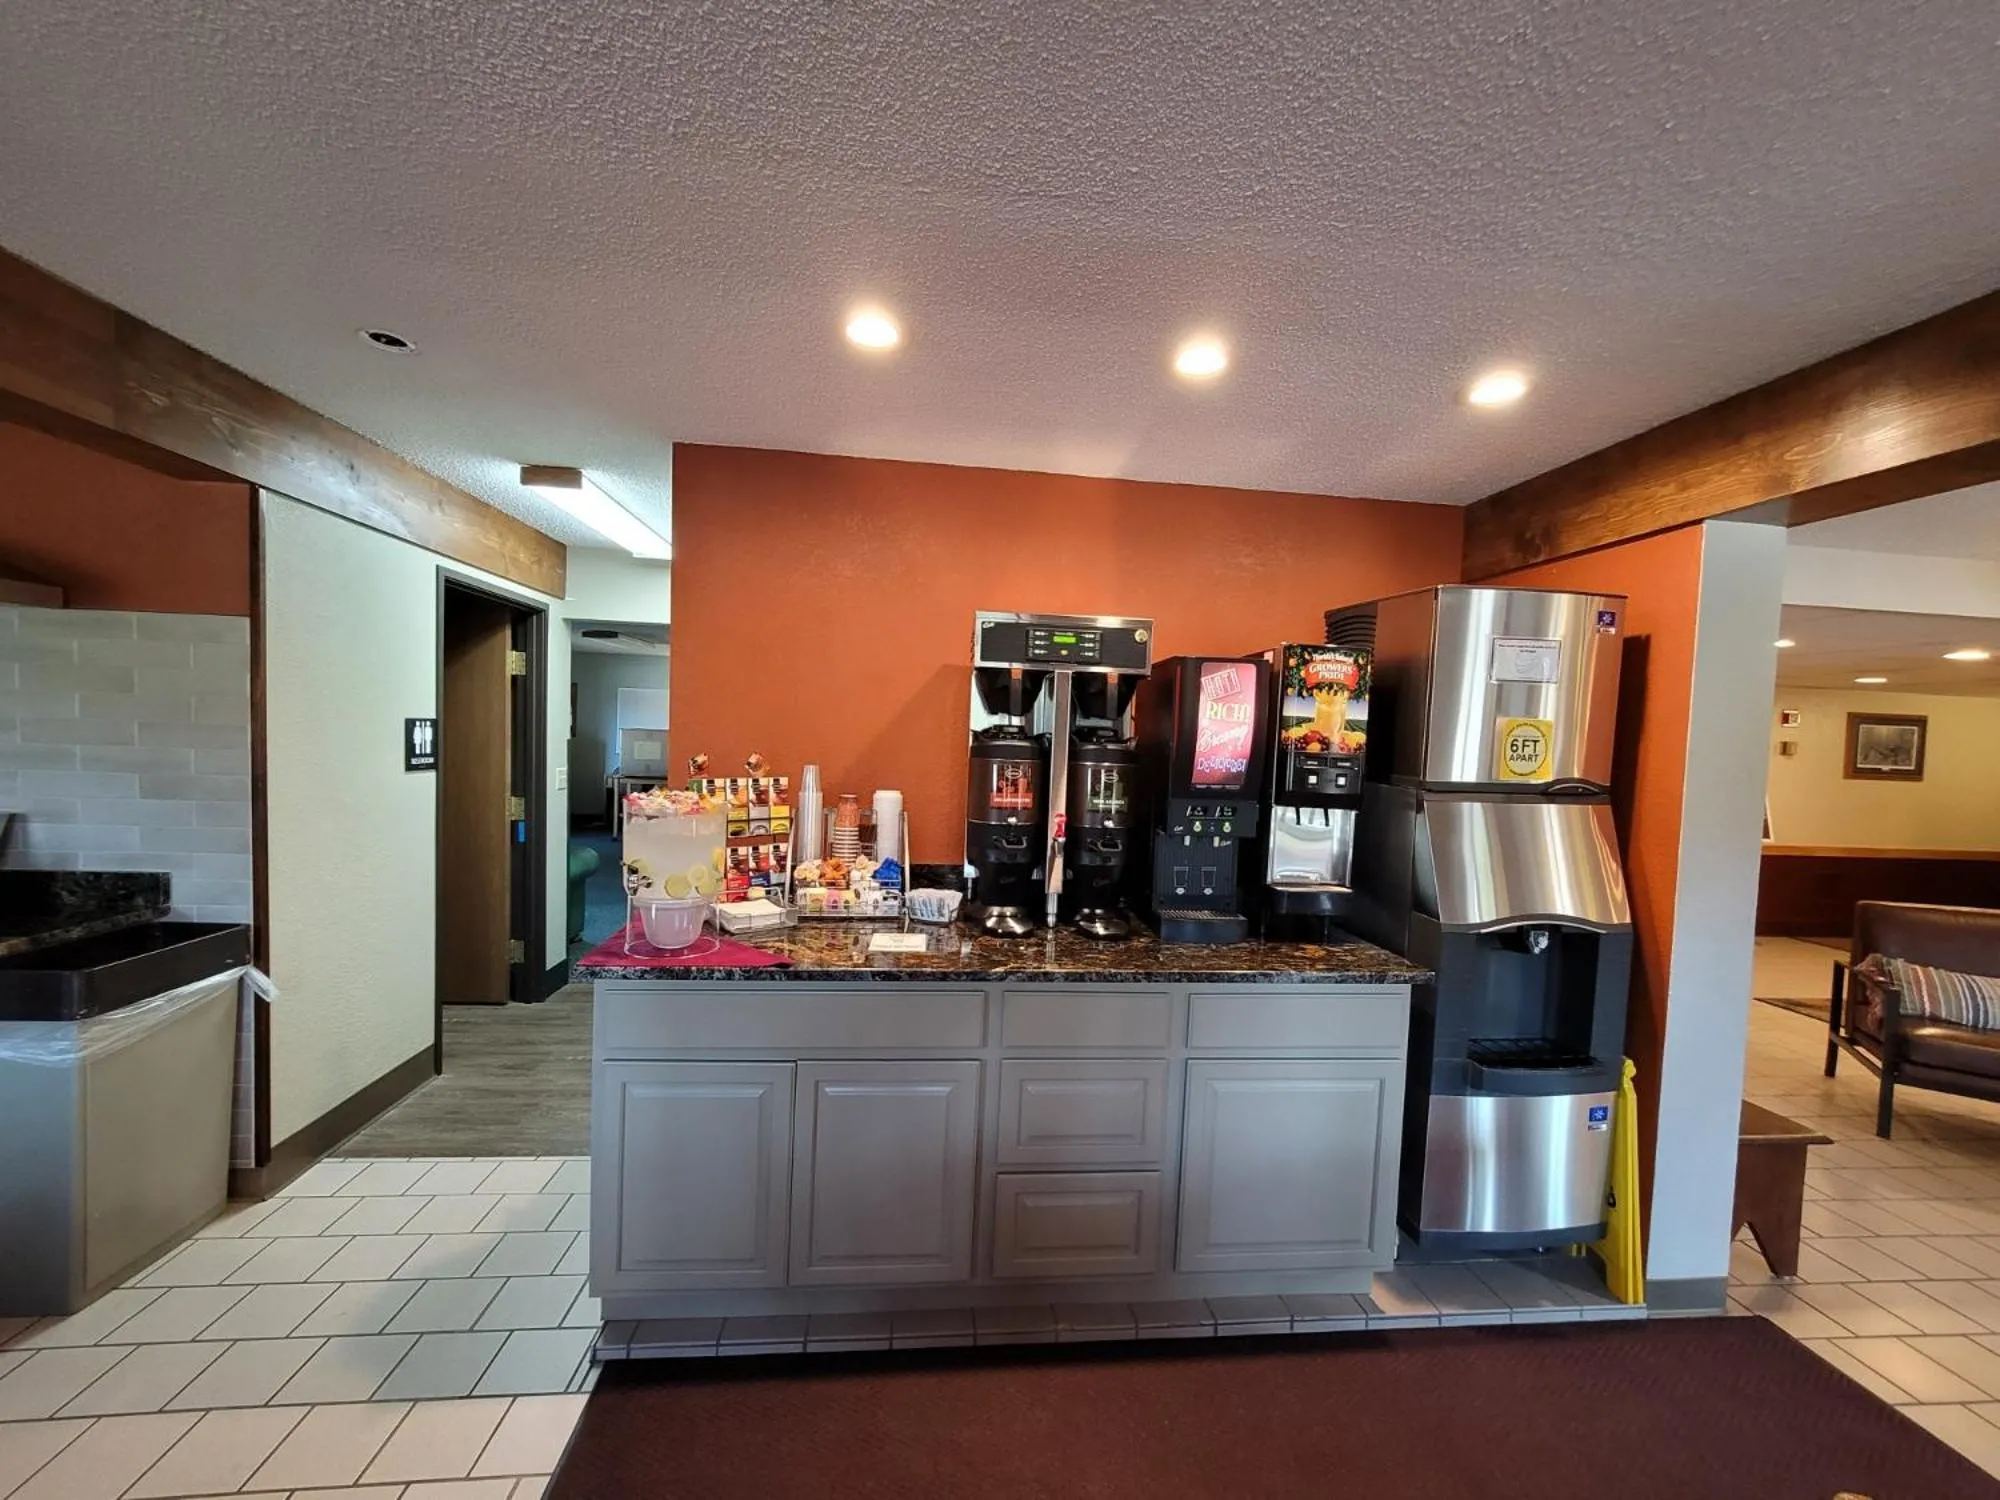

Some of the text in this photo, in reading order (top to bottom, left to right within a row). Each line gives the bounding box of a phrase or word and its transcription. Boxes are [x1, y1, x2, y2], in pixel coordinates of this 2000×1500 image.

[1206, 702, 1249, 722] RICH!
[1510, 738, 1540, 753] 6 FT
[1509, 754, 1540, 763] APART
